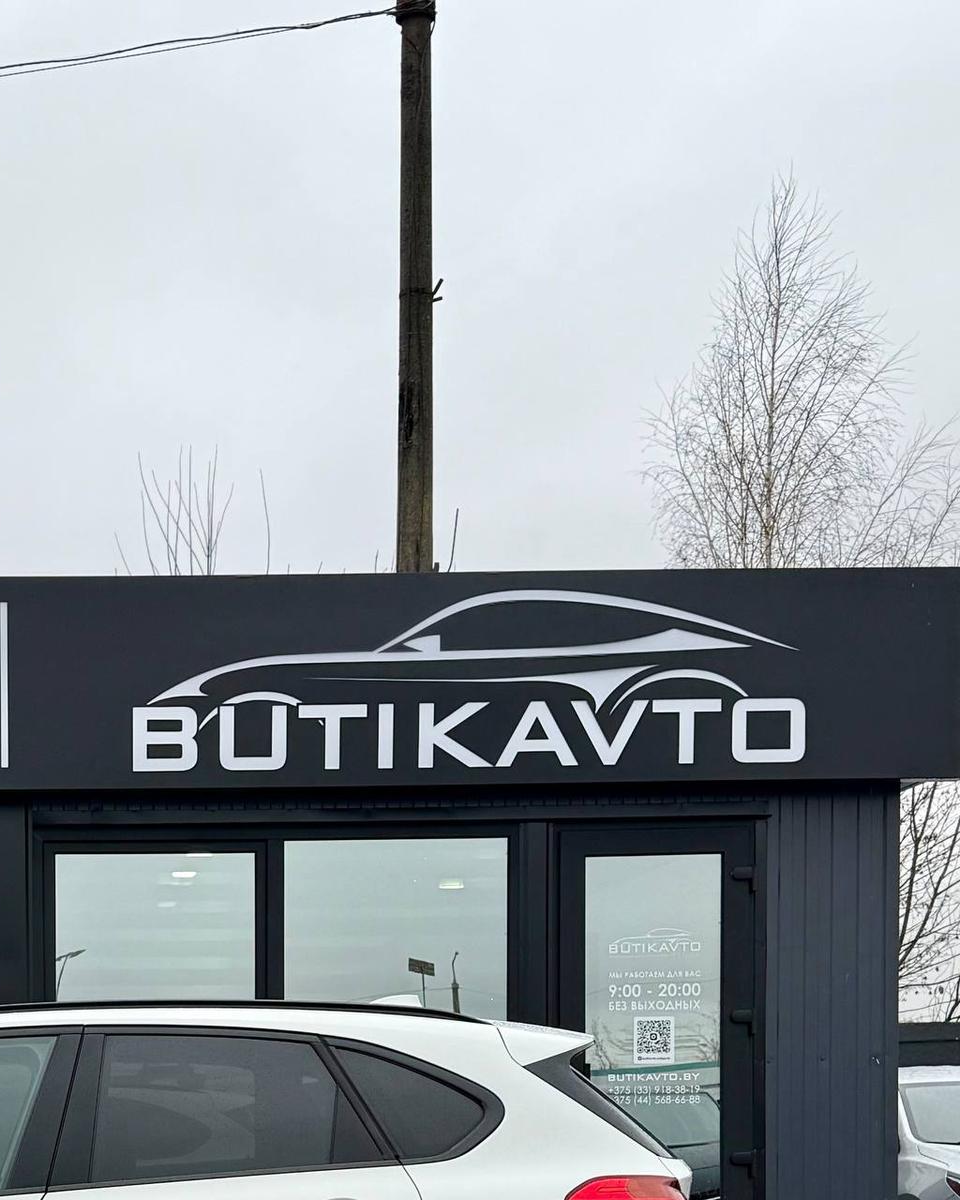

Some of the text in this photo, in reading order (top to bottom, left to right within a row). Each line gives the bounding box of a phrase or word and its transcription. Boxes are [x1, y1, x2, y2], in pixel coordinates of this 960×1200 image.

[132, 697, 807, 773] BUTIKAVTO
[608, 942, 701, 954] BUTIKAVTO
[608, 984, 641, 998] 9:00
[658, 982, 701, 997] 20:00
[608, 999, 701, 1011] БЕЗ ВЫХОДНЫХ
[607, 1072, 700, 1082] BUTIKAVTO.BY
[608, 1086, 631, 1095] +375
[654, 1084, 701, 1094] 918-38-19
